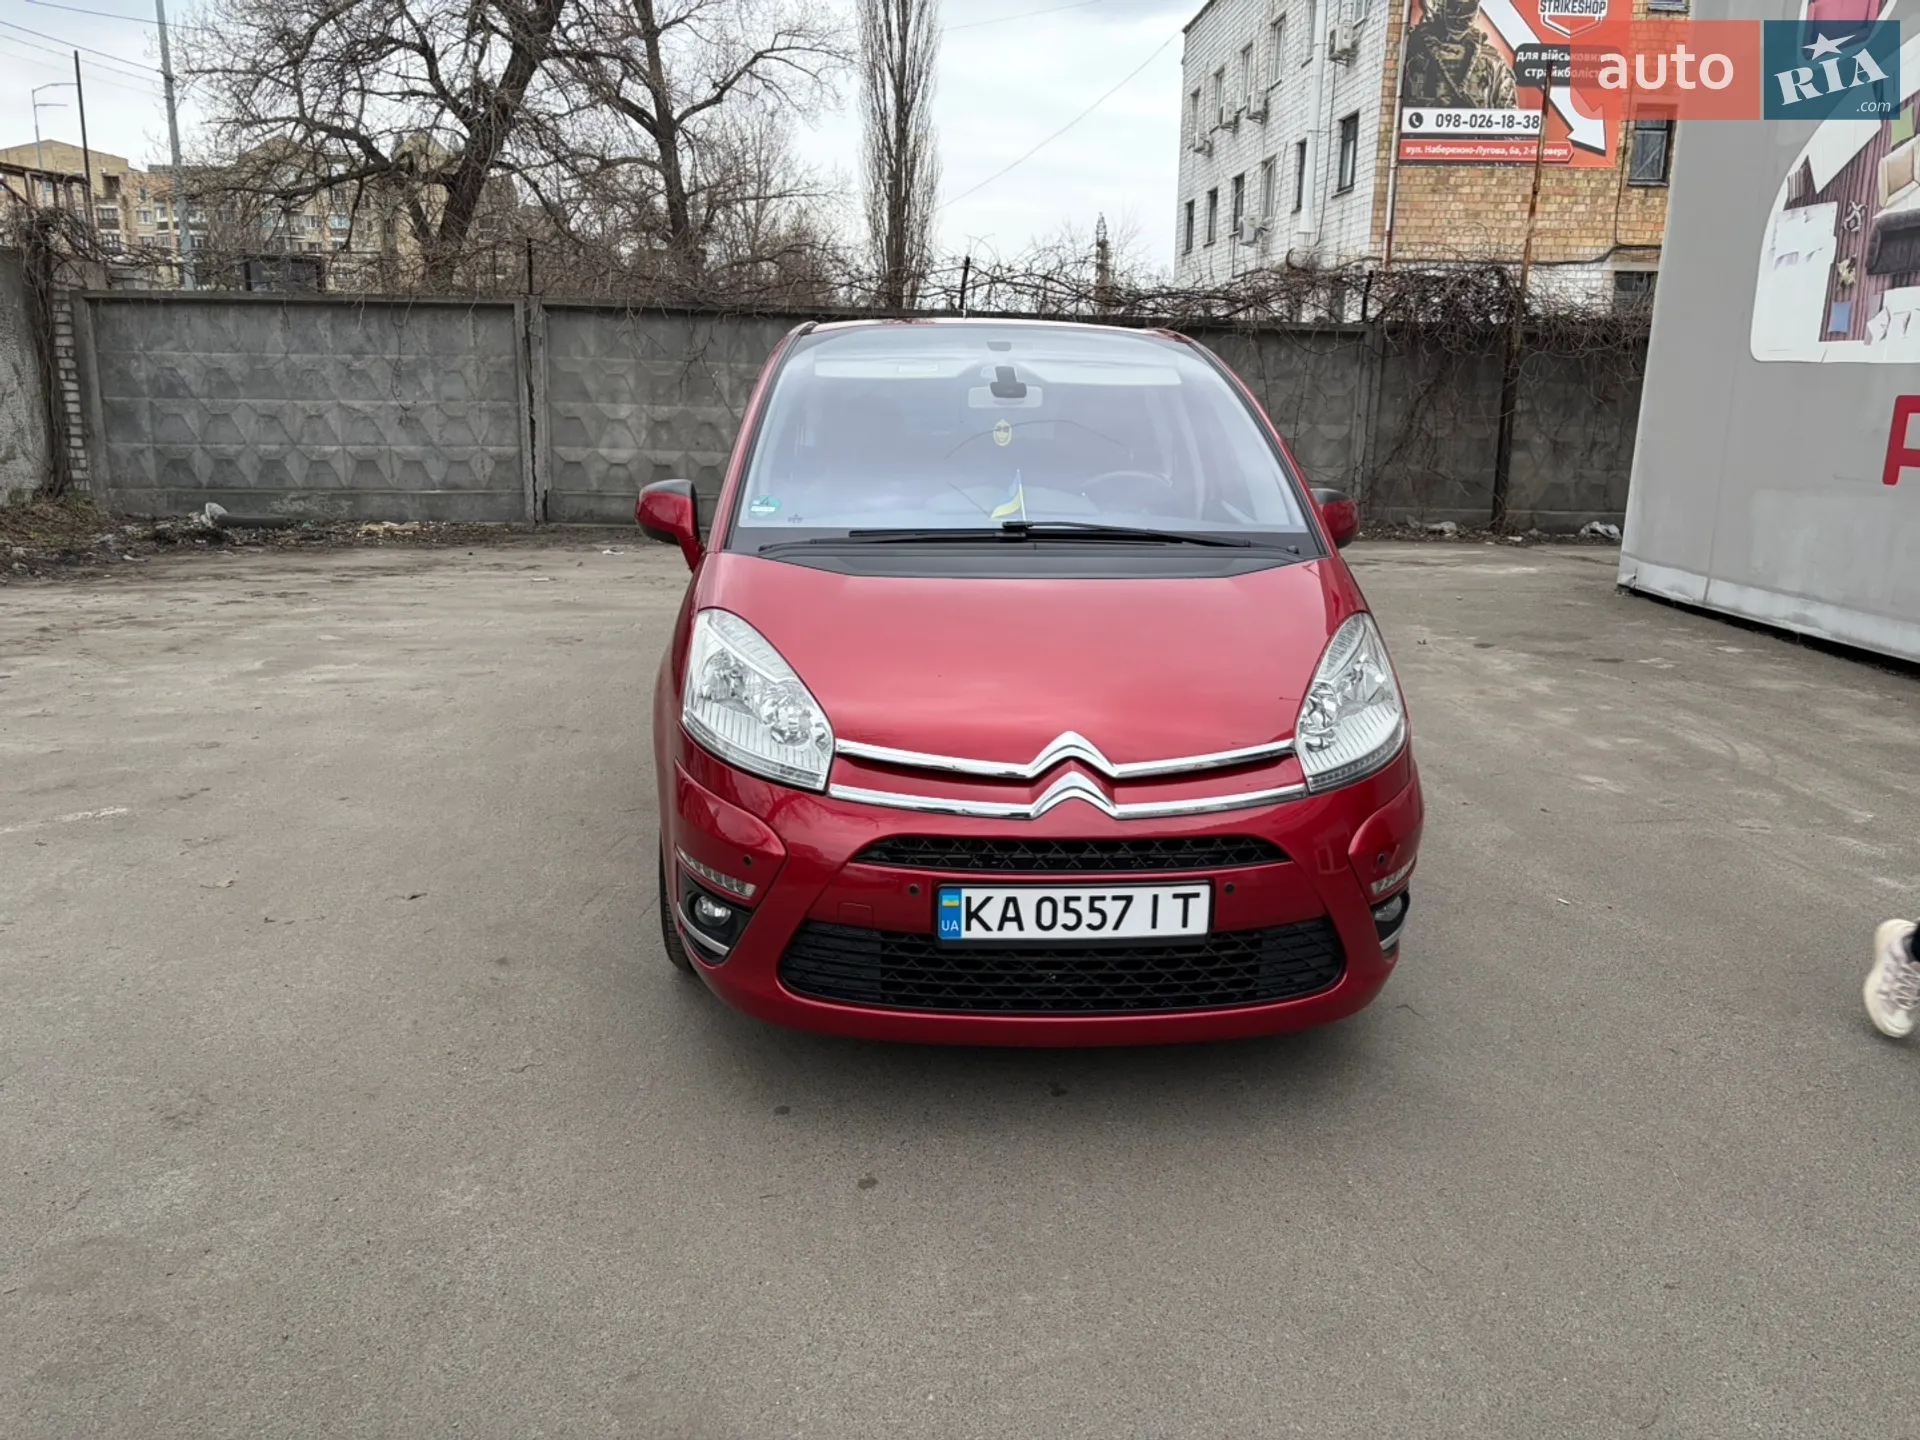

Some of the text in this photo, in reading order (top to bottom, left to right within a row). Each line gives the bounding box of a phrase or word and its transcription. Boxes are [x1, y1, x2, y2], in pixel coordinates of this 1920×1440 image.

[1540, 0, 1606, 14] STRIKESHOP
[1516, 51, 1539, 62] для
[1435, 113, 1540, 129] 098-026-18-38
[1538, 148, 1569, 158] оверх
[965, 892, 1201, 932] KA 0557 IT
[941, 919, 960, 932] UA
